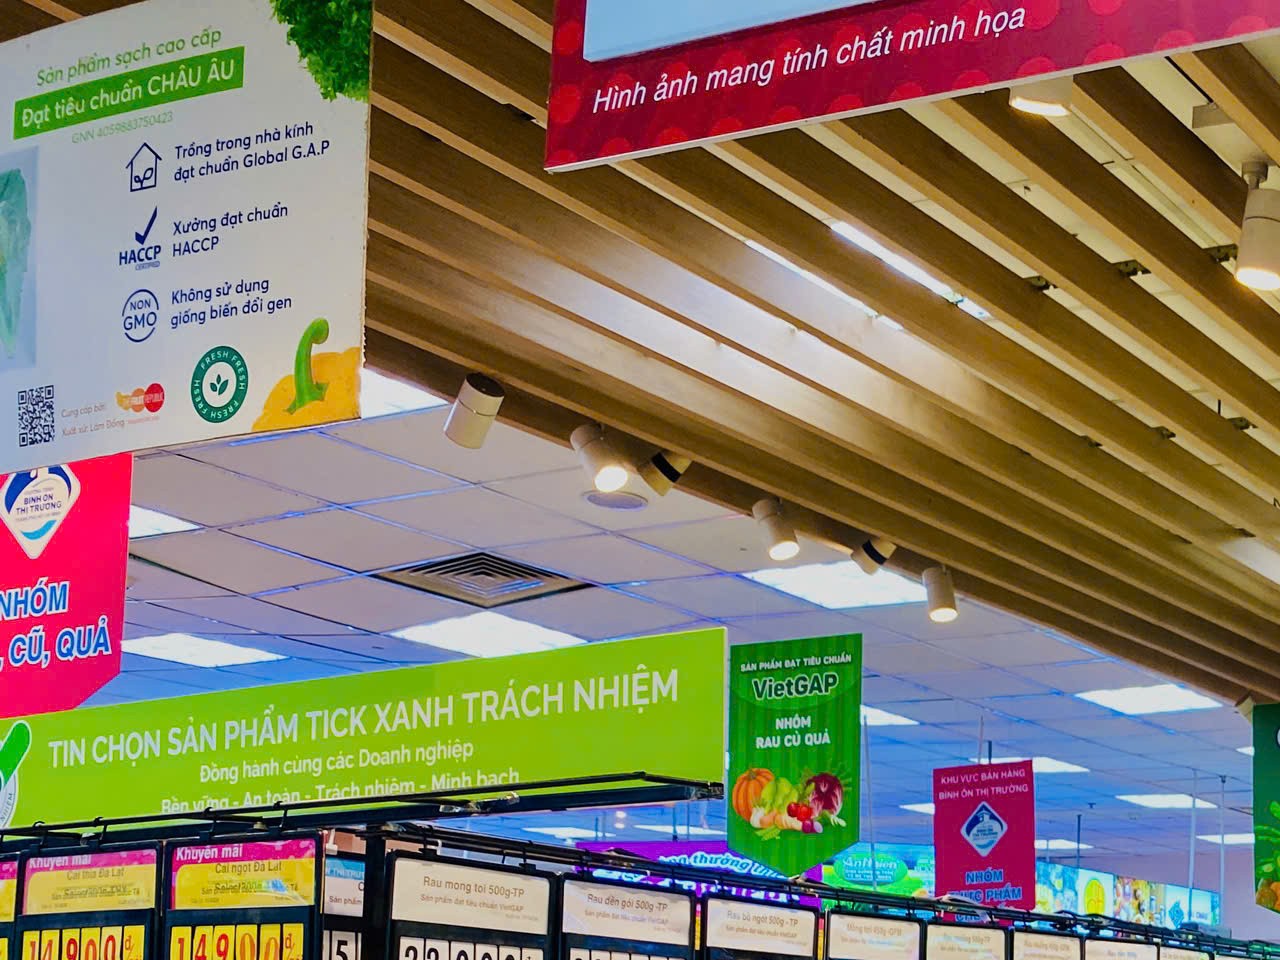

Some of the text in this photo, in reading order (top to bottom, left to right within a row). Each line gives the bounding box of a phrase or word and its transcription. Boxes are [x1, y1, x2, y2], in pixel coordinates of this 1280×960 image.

[37, 26, 222, 86] Sản phẩm sạch cao cấp
[593, 6, 1024, 114] Hình ảnh mang tính chất minh họa
[22, 58, 235, 128] Đạt tiêu chuẩn CHÂU ÂU
[175, 121, 314, 162] Trồng trong nhà kính
[174, 140, 330, 183] đạt chuẩn Global G.A.P
[173, 202, 288, 236] Xưởng đạt chuẩn
[119, 246, 161, 265] HACCP
[173, 236, 219, 257] HACCP
[130, 299, 151, 311] NON
[171, 278, 269, 305] Không sử dụng
[123, 311, 157, 331] GMO
[171, 296, 291, 328] giống biến đổi gen
[194, 351, 246, 419] FRESH FRESH FRESH FRESH
[0, 578, 69, 619] NHÓM
[784, 659, 801, 669] ĐẠT
[803, 656, 821, 666] TIÊU
[823, 651, 852, 664] CHUẨN
[752, 672, 839, 700] VietGAP
[48, 663, 678, 769] TIN CHỌN SẢN PHẨM TICK XANH TRÁCH NHIỆM
[775, 713, 811, 730] NHÓM
[756, 728, 831, 749] RAU CỦ QUẢ
[200, 738, 474, 785] Đồng hành cùng các Doanh nghiệp
[940, 767, 1025, 785] KHU VỰC BÁN HÀNG
[965, 867, 1003, 884] NHÓM
